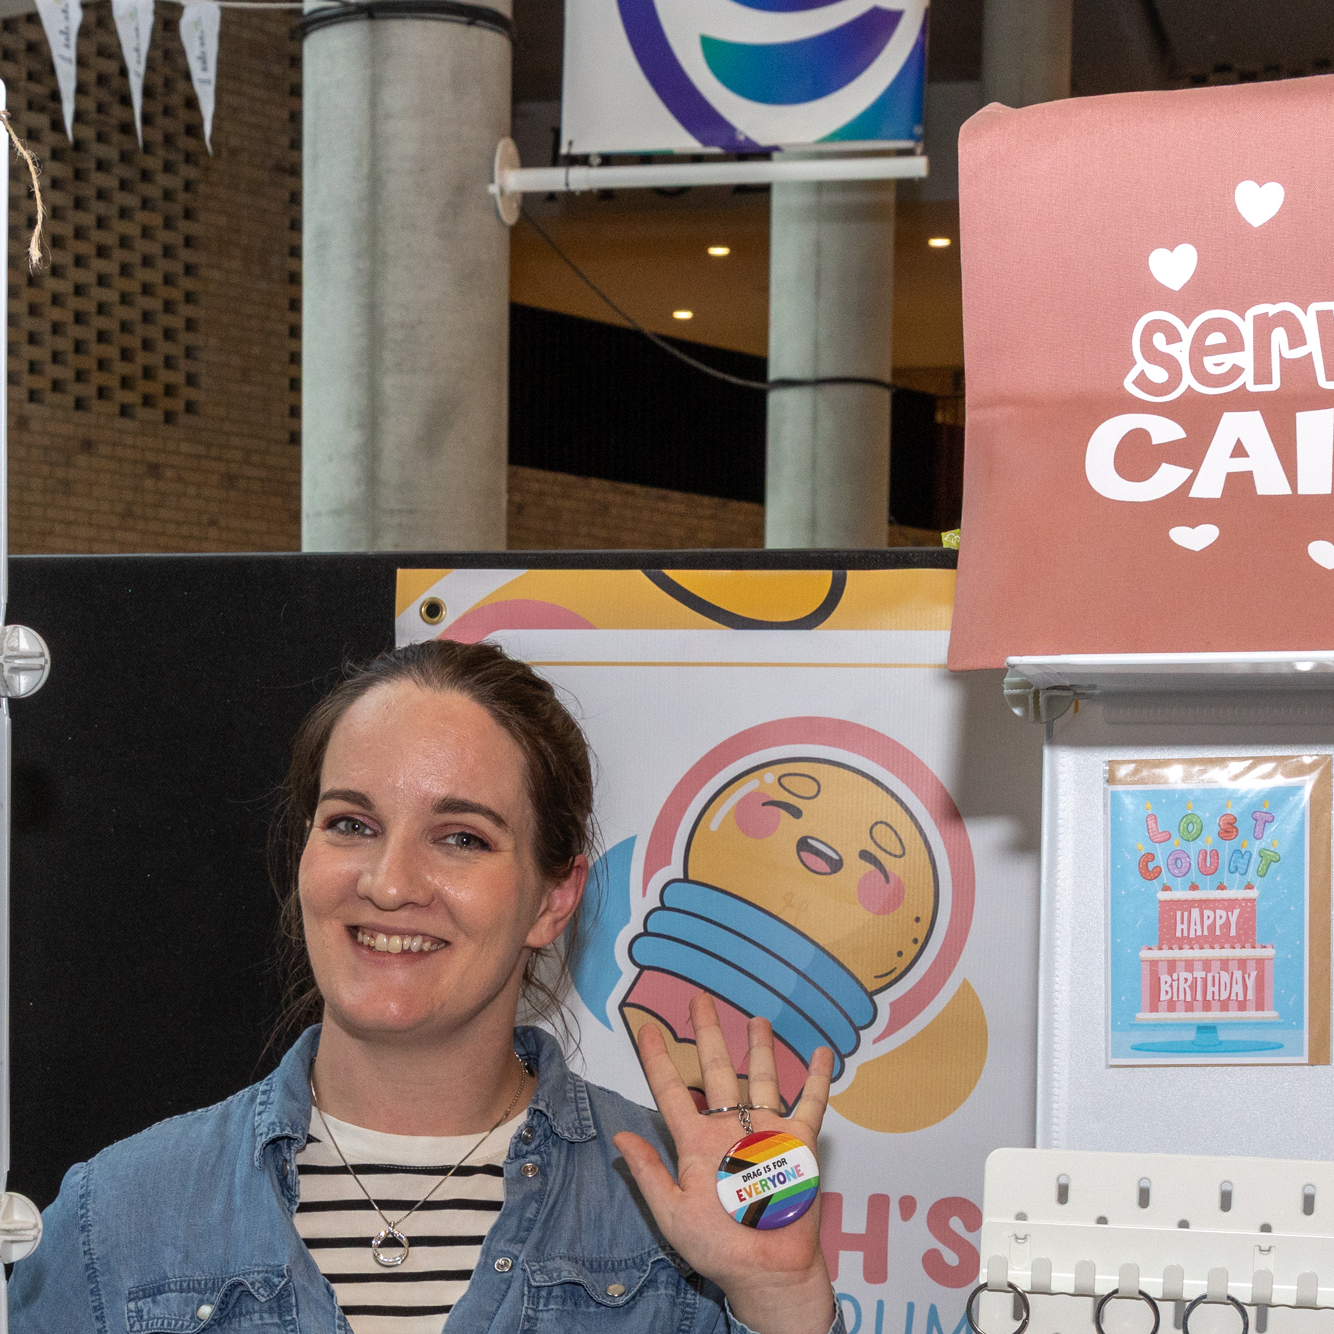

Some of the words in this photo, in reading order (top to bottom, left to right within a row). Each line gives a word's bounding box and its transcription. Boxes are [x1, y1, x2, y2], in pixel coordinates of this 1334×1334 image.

[1145, 810, 1274, 844] LOST
[1138, 848, 1281, 881] COUNT
[1175, 908, 1240, 938] HAPPY
[736, 1163, 804, 1203] EVERYONE
[742, 1168, 762, 1183] DRAG
[763, 1165, 772, 1174] IS
[772, 1157, 787, 1169] FOR
